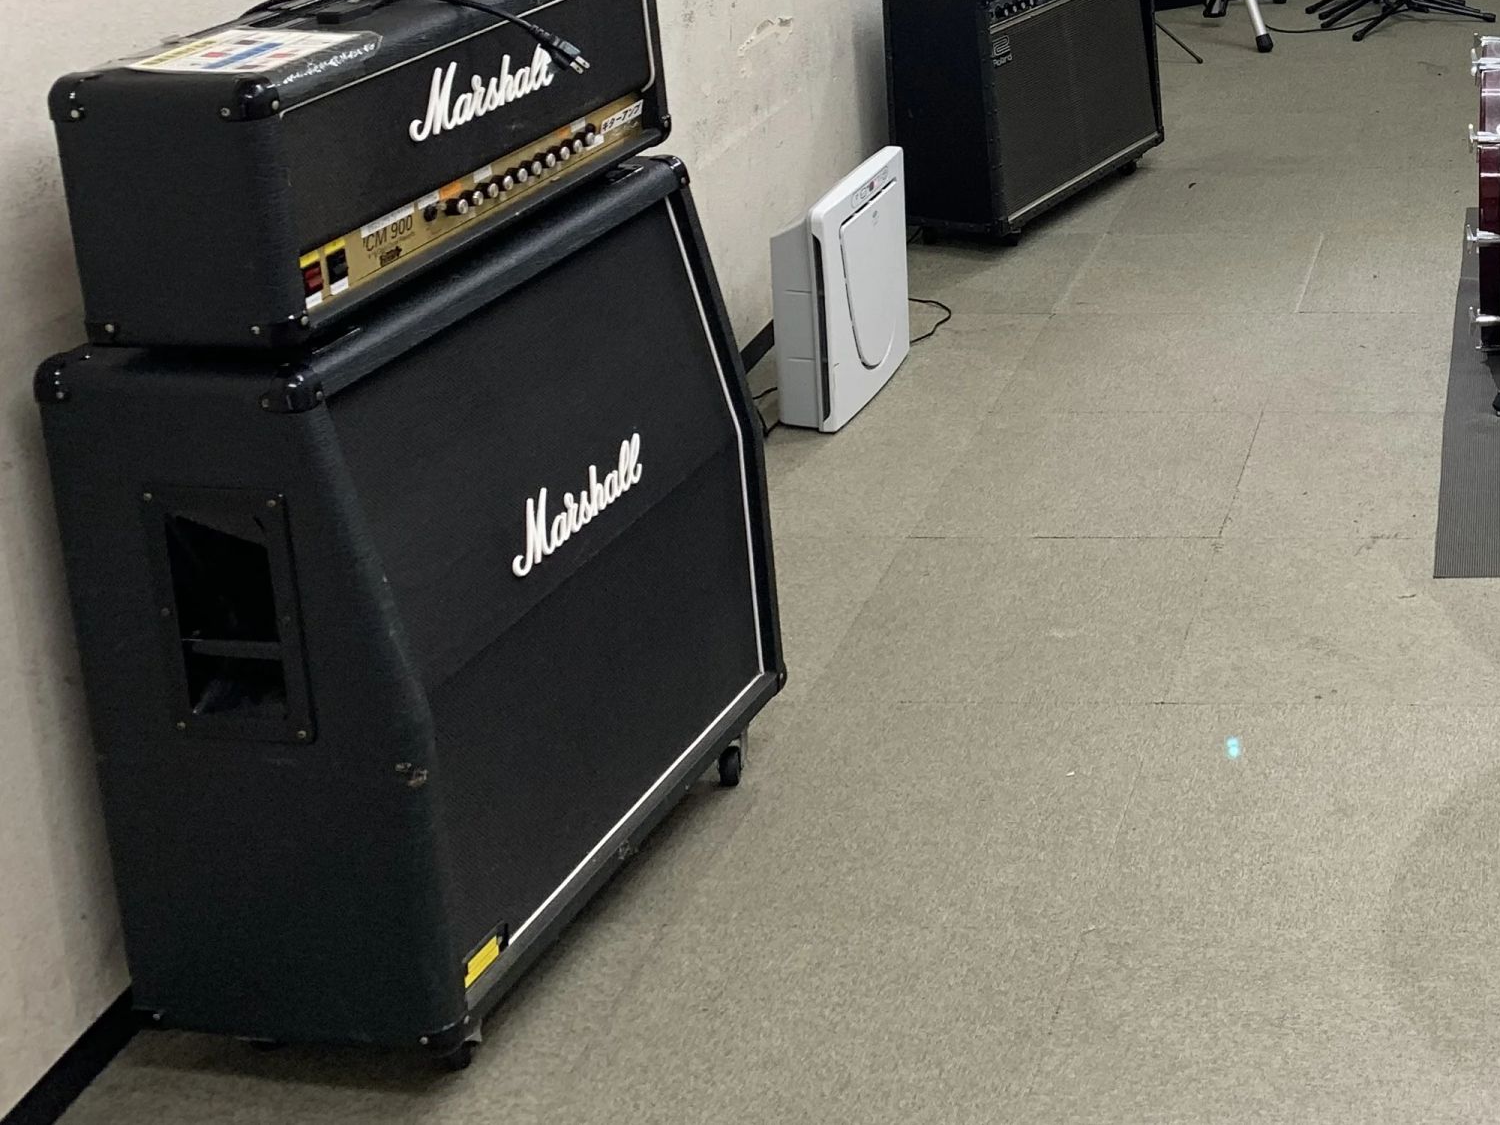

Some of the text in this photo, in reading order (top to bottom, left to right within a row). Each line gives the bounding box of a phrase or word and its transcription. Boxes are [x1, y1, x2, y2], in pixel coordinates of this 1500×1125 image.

[409, 43, 554, 142] Marshall
[391, 215, 413, 239] 900
[512, 432, 643, 577] Marshall
